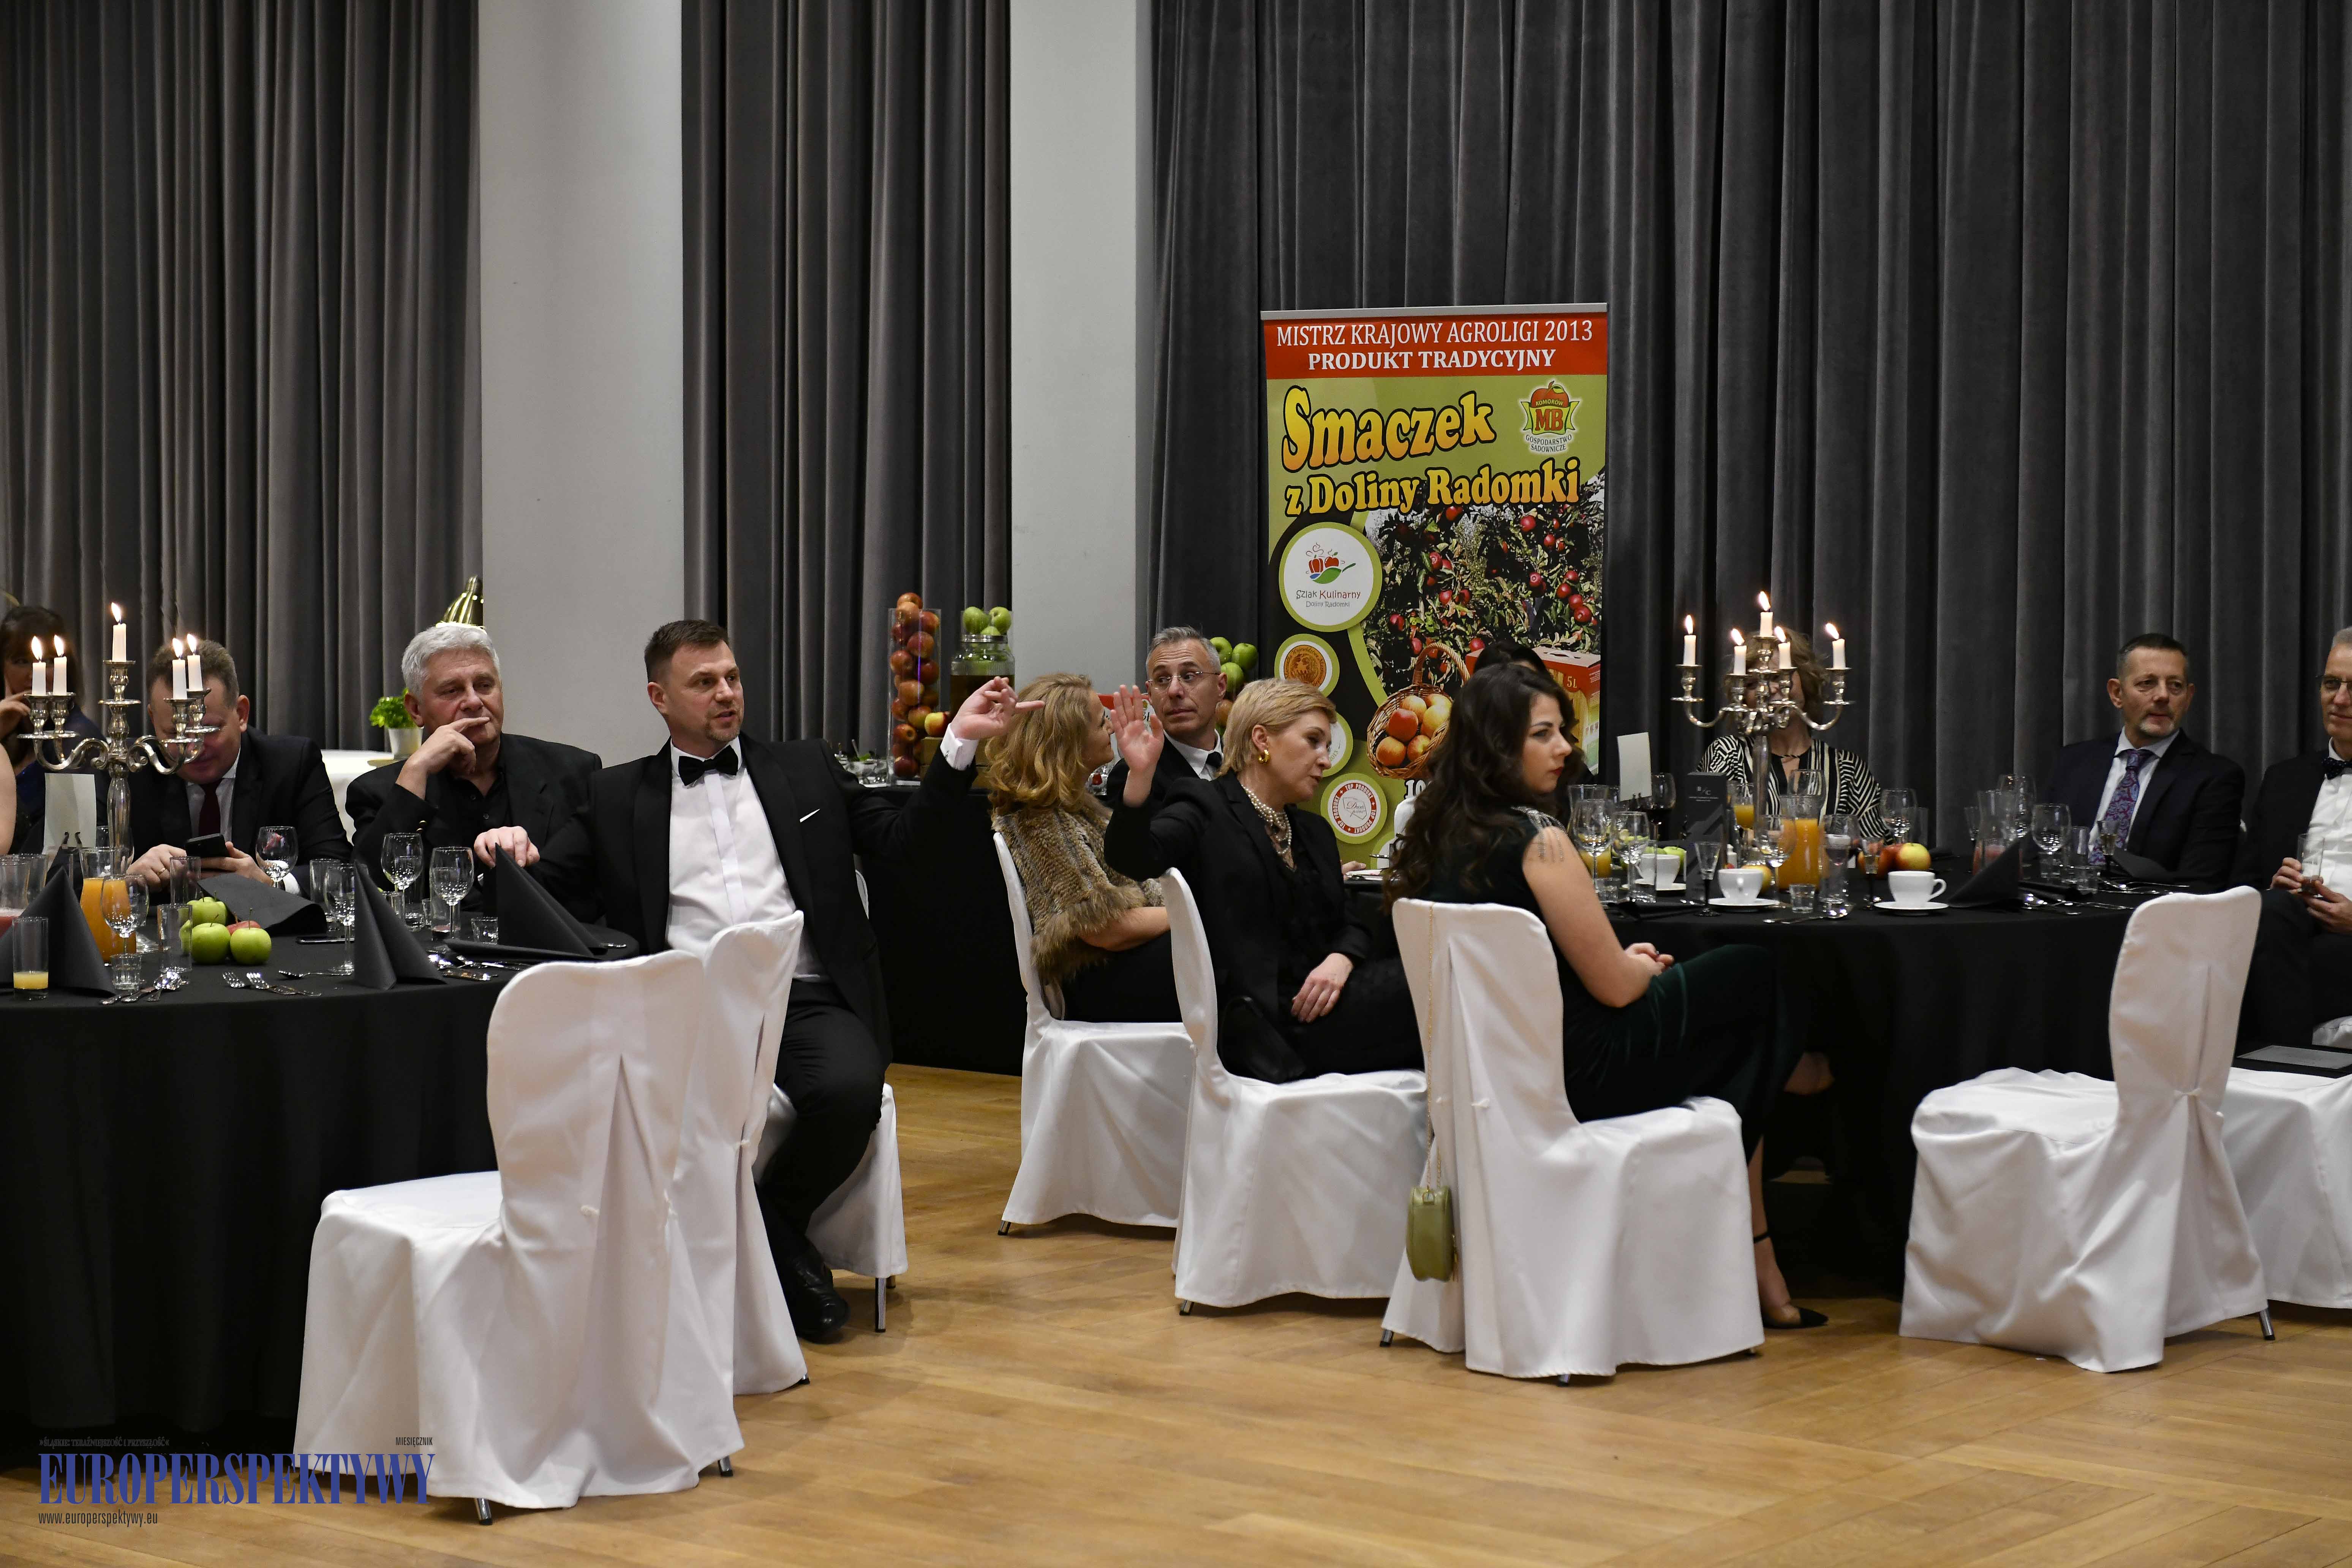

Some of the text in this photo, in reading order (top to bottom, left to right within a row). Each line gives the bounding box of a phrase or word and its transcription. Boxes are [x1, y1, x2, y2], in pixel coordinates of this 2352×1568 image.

[1277, 320, 1593, 349] MISTRZ KRAJOWY AGROLIGI 2013
[1308, 349, 1556, 371] PRODUKT TRADYCYJNY
[1535, 409, 1564, 430] MB
[1282, 386, 1496, 472] Smaczek
[1525, 434, 1572, 446] GOSPODARSTWO
[1531, 444, 1566, 452] SADOWNICZE
[1285, 457, 1580, 517] z Doliny Radomki
[1296, 590, 1361, 600] Szlak Kulinarny
[1566, 676, 1577, 688] 5L
[1356, 783, 1374, 799] PRODUKT
[1354, 819, 1373, 833] PRODUKT
